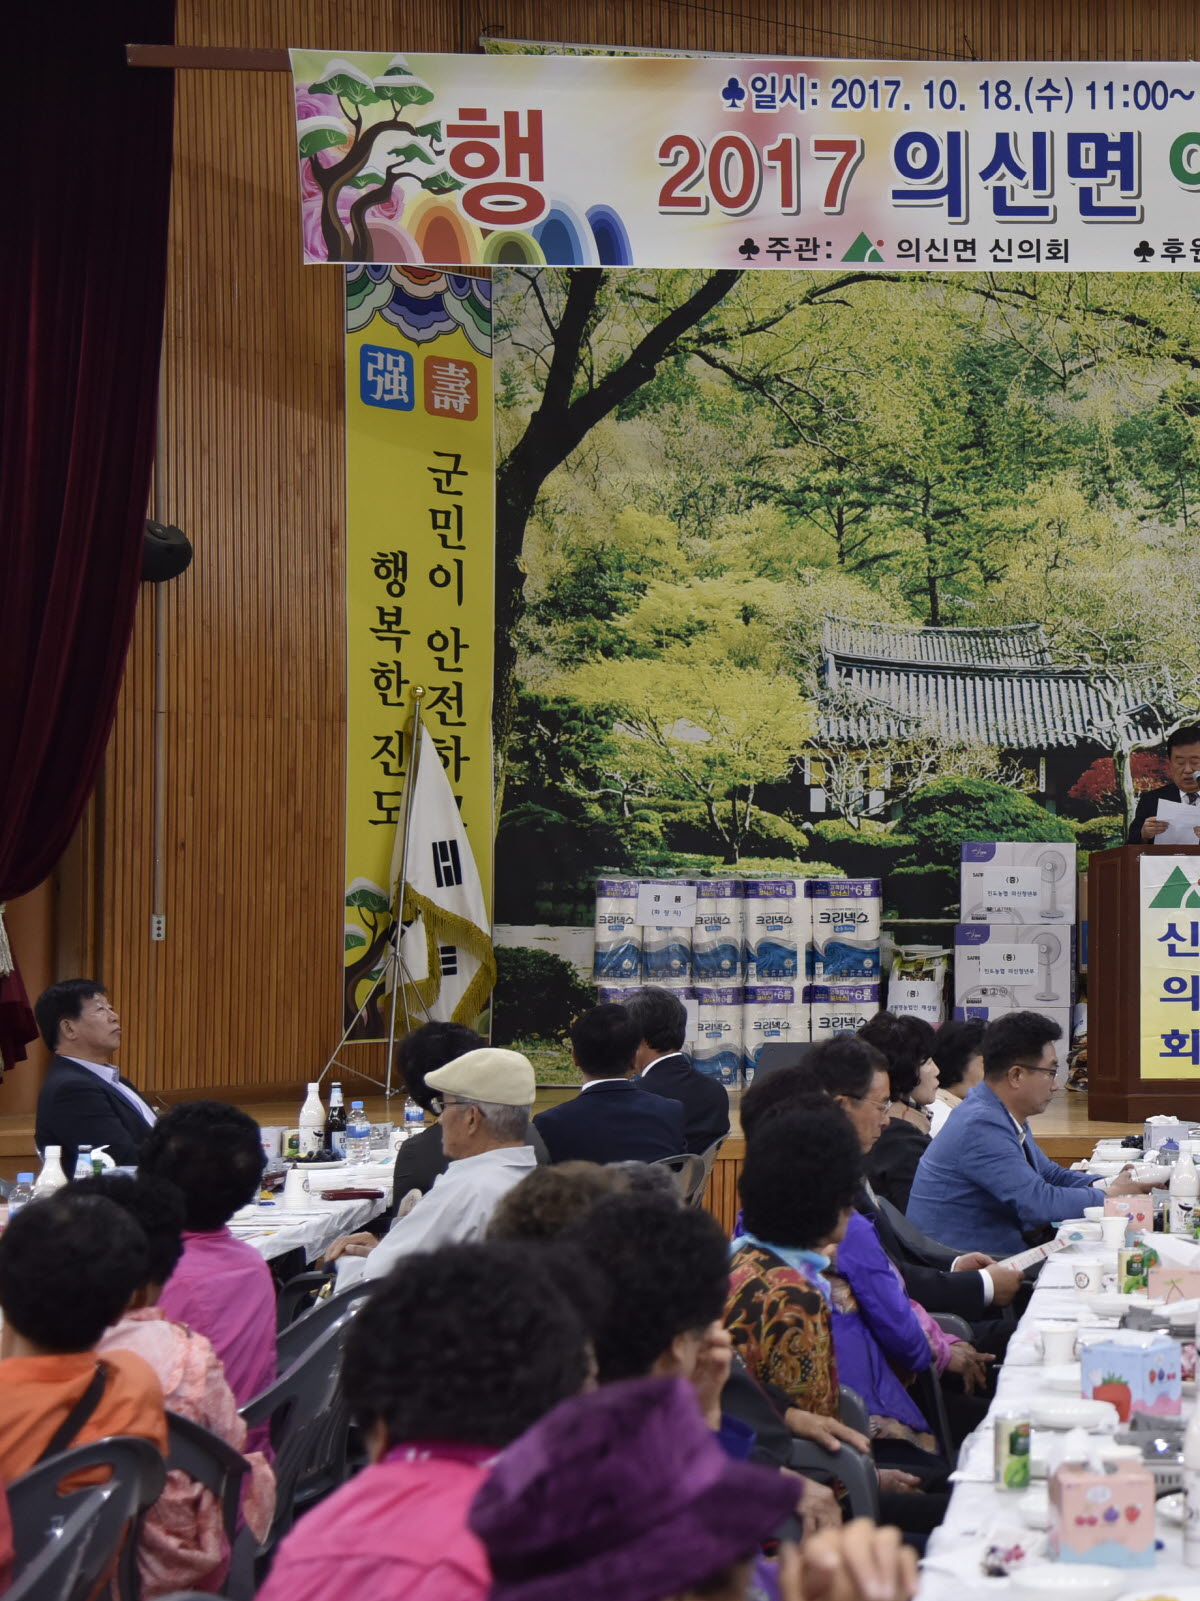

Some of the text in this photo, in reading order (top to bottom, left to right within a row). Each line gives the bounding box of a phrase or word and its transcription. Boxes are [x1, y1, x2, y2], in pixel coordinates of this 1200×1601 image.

[751, 76, 1195, 114] 일시: 2017. 10. 18.(수) 11:00~
[446, 107, 546, 226] 행
[657, 133, 861, 212] 2017
[890, 130, 1139, 219] 의신면
[765, 236, 1070, 263] 주관: 의신면 신의회
[432, 362, 472, 413] 壽
[426, 450, 470, 829] 군민이 안전하
[367, 550, 411, 826] 행복한 진도
[755, 915, 794, 925] 크리넥스
[818, 911, 870, 925] 크리넥스
[1157, 920, 1200, 1066] 신의회
[753, 1020, 791, 1030] 크리넥스
